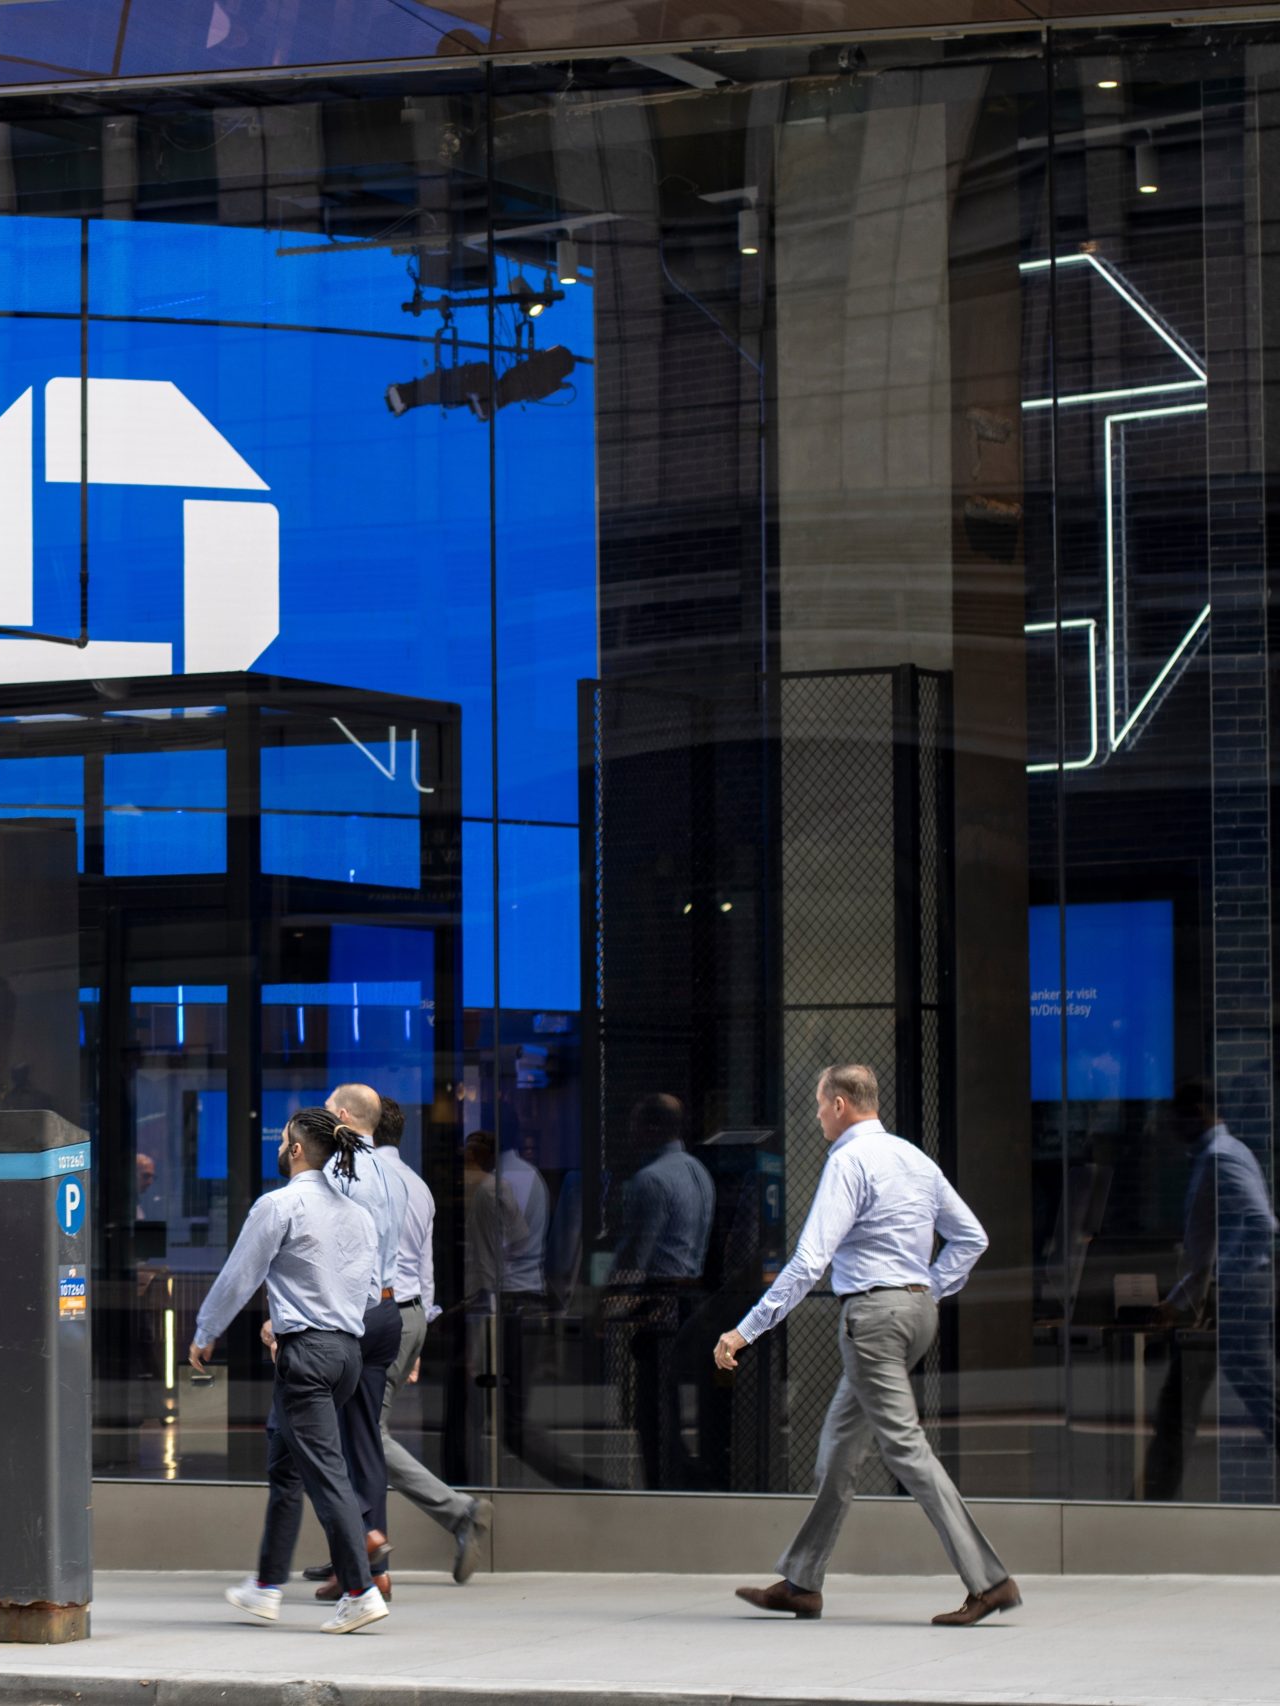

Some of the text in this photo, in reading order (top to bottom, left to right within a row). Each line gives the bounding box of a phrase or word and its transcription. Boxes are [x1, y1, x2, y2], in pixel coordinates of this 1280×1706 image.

[1076, 987, 1098, 1000] visit
[58, 1152, 85, 1169] 107260
[66, 1183, 81, 1227] P
[60, 1283, 85, 1297] 107260
